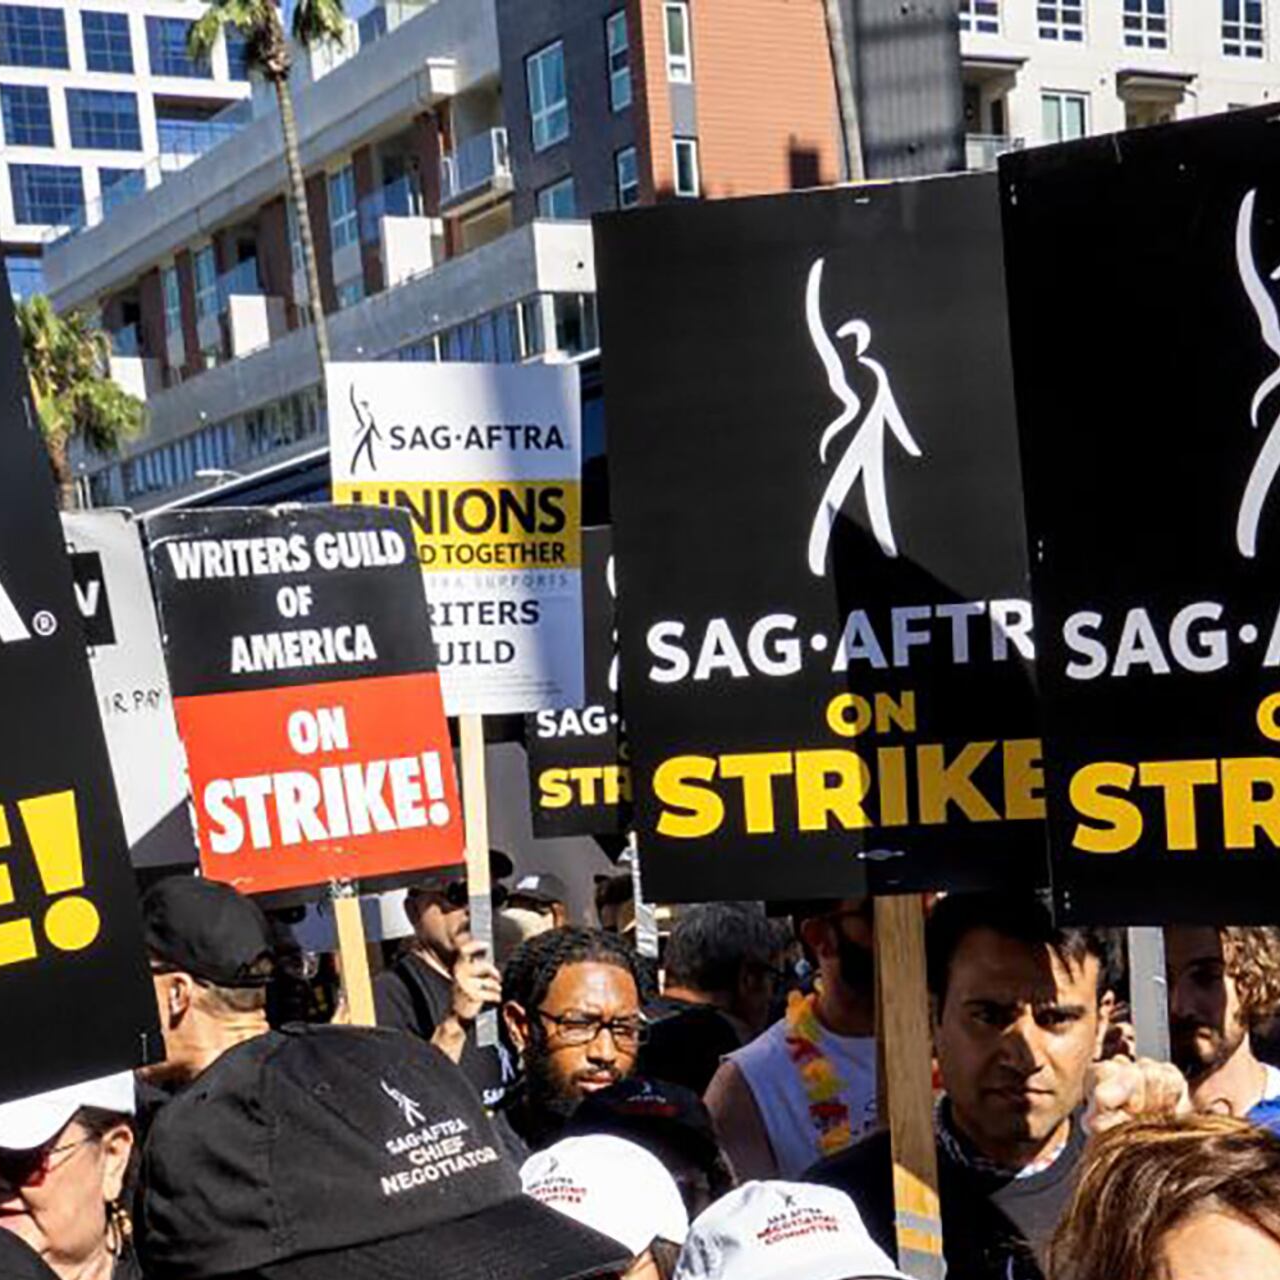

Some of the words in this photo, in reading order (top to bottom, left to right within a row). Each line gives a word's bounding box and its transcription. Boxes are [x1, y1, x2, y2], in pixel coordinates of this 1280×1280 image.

[352, 487, 566, 536] NIONS
[166, 535, 311, 580] WRITERS
[314, 530, 406, 569] GUILD
[440, 541, 566, 565] TOGETHER
[277, 586, 313, 618] OF
[427, 600, 540, 627] RITERS
[230, 624, 377, 674] AMERICA
[438, 640, 515, 666] UILD
[287, 706, 349, 757] ON
[826, 691, 917, 737] ON
[203, 751, 451, 854] STRIKE!
[380, 1147, 500, 1196] NEGOTIATOR
[409, 1136, 465, 1165] CHIEF
